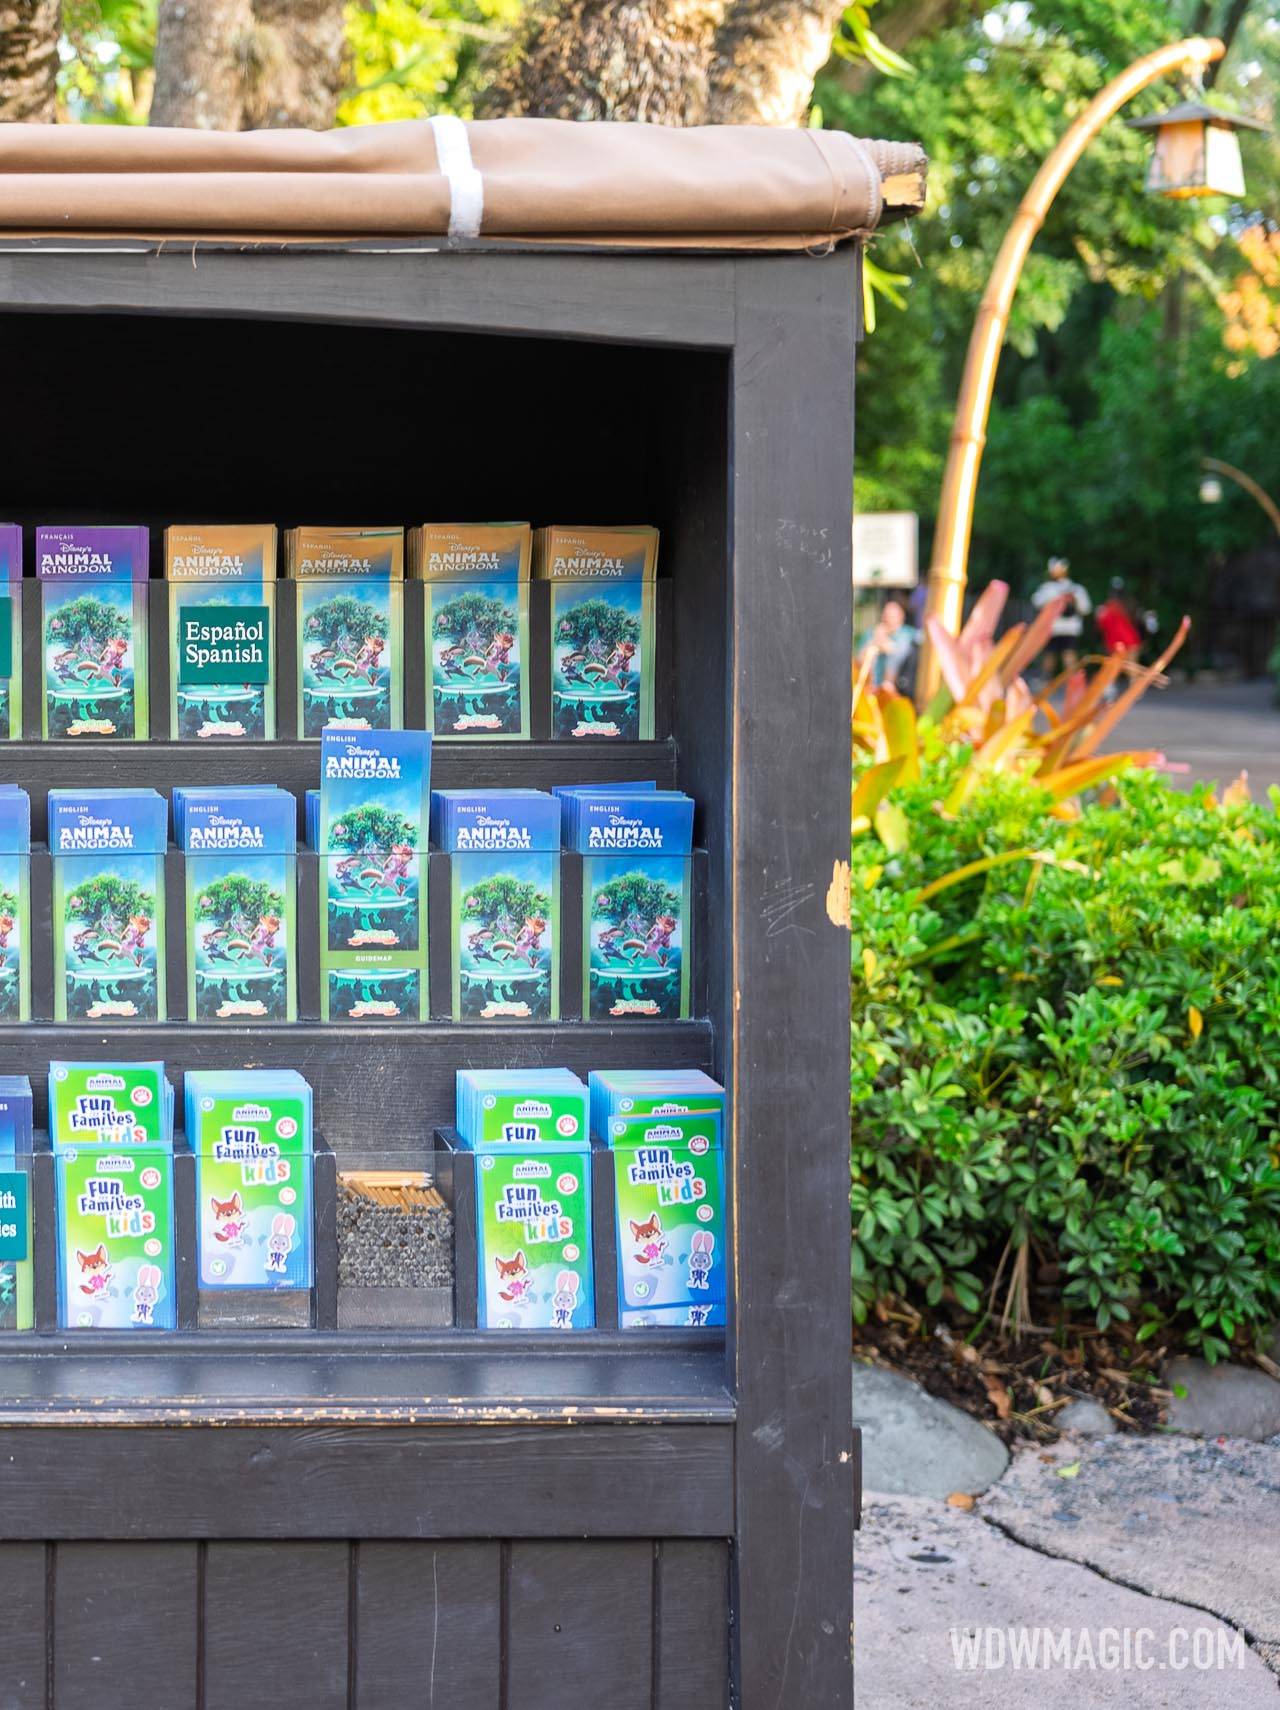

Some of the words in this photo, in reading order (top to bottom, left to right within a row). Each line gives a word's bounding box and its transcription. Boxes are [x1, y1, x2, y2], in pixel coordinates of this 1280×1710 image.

[59, 542, 92, 554] Disney's
[41, 554, 112, 566] ANIMAL
[172, 555, 243, 567] ANIMAL
[300, 559, 371, 568] ANIMAL
[429, 552, 500, 563] ANIMAL
[554, 557, 625, 569] ANIMAL
[41, 564, 112, 574] KINGDOM
[172, 566, 243, 576] KINGDOM
[300, 566, 371, 574] KINGDOM
[429, 562, 500, 572] KINGDOM
[553, 567, 624, 576] KINGDOM
[185, 621, 263, 645] Español
[186, 644, 263, 667] Spanish
[345, 745, 380, 757] Disney's
[326, 756, 401, 769] ANIMAL
[326, 768, 402, 779] KINGDOM
[77, 815, 112, 827] Disney's
[208, 815, 242, 827] Disney's
[476, 815, 510, 828] Disney's
[608, 815, 643, 827] Disney's
[59, 827, 134, 839] ANIMAL
[190, 827, 264, 839] ANIMAL
[457, 827, 531, 839] ANIMAL
[589, 827, 663, 839] ANIMAL
[59, 838, 134, 849] KINGDOM
[190, 838, 264, 849] KINGDOM
[457, 838, 532, 849] KINGDOM
[589, 837, 663, 848] KINGDOM
[80, 1097, 111, 1113] Fun
[72, 1112, 133, 1127] Families
[225, 1128, 256, 1144] Fun
[505, 1126, 536, 1141] Fun
[216, 1144, 277, 1160] Families
[638, 1149, 670, 1163] Fun
[245, 1161, 288, 1182] kids
[631, 1164, 692, 1182] Families
[88, 1180, 120, 1196] Fun
[661, 1180, 703, 1202] kids
[507, 1187, 537, 1203] Fun
[81, 1196, 142, 1212] Families
[498, 1202, 559, 1219] Families
[109, 1214, 152, 1235] kids
[527, 1220, 570, 1241] kids
